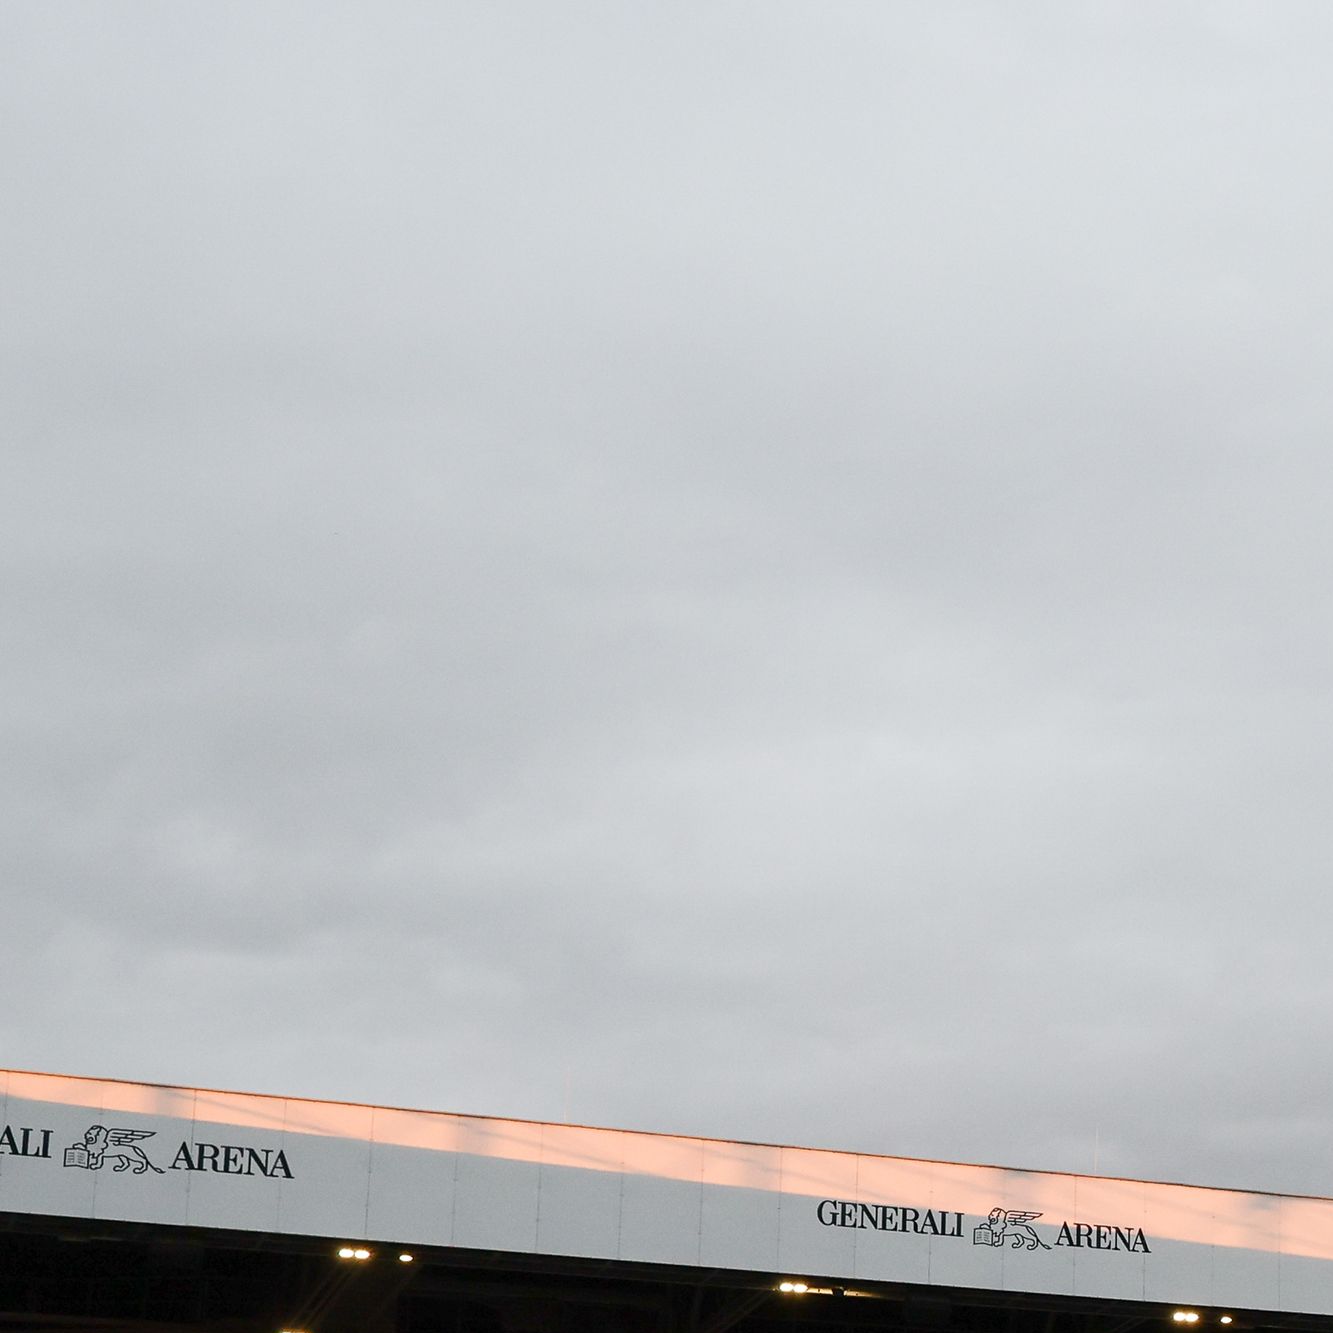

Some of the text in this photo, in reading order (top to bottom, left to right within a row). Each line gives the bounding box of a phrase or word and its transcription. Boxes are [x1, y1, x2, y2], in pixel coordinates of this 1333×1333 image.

[168, 1142, 295, 1180] ARENA
[816, 1199, 1152, 1254] GENERALI ARENA
